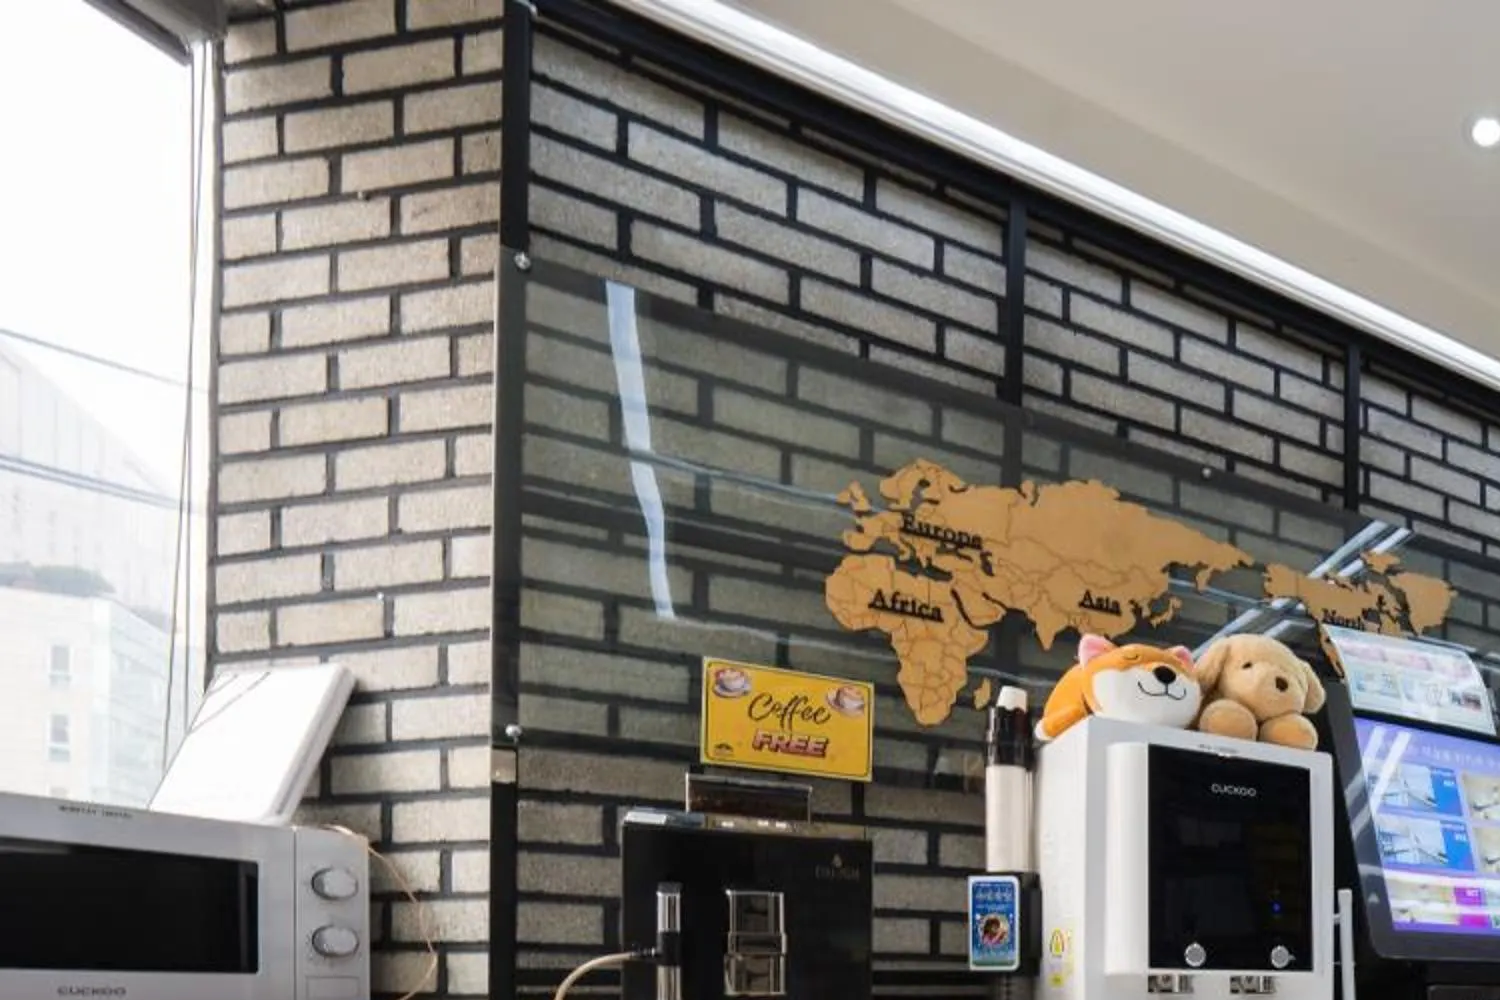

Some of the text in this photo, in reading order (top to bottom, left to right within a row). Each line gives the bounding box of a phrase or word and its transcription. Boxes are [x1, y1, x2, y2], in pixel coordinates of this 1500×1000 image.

[867, 587, 945, 623] Africa
[1078, 589, 1122, 616] Asia
[747, 691, 832, 732] Coffee
[751, 728, 830, 758] FREE
[56, 984, 127, 997] CUCKOO
